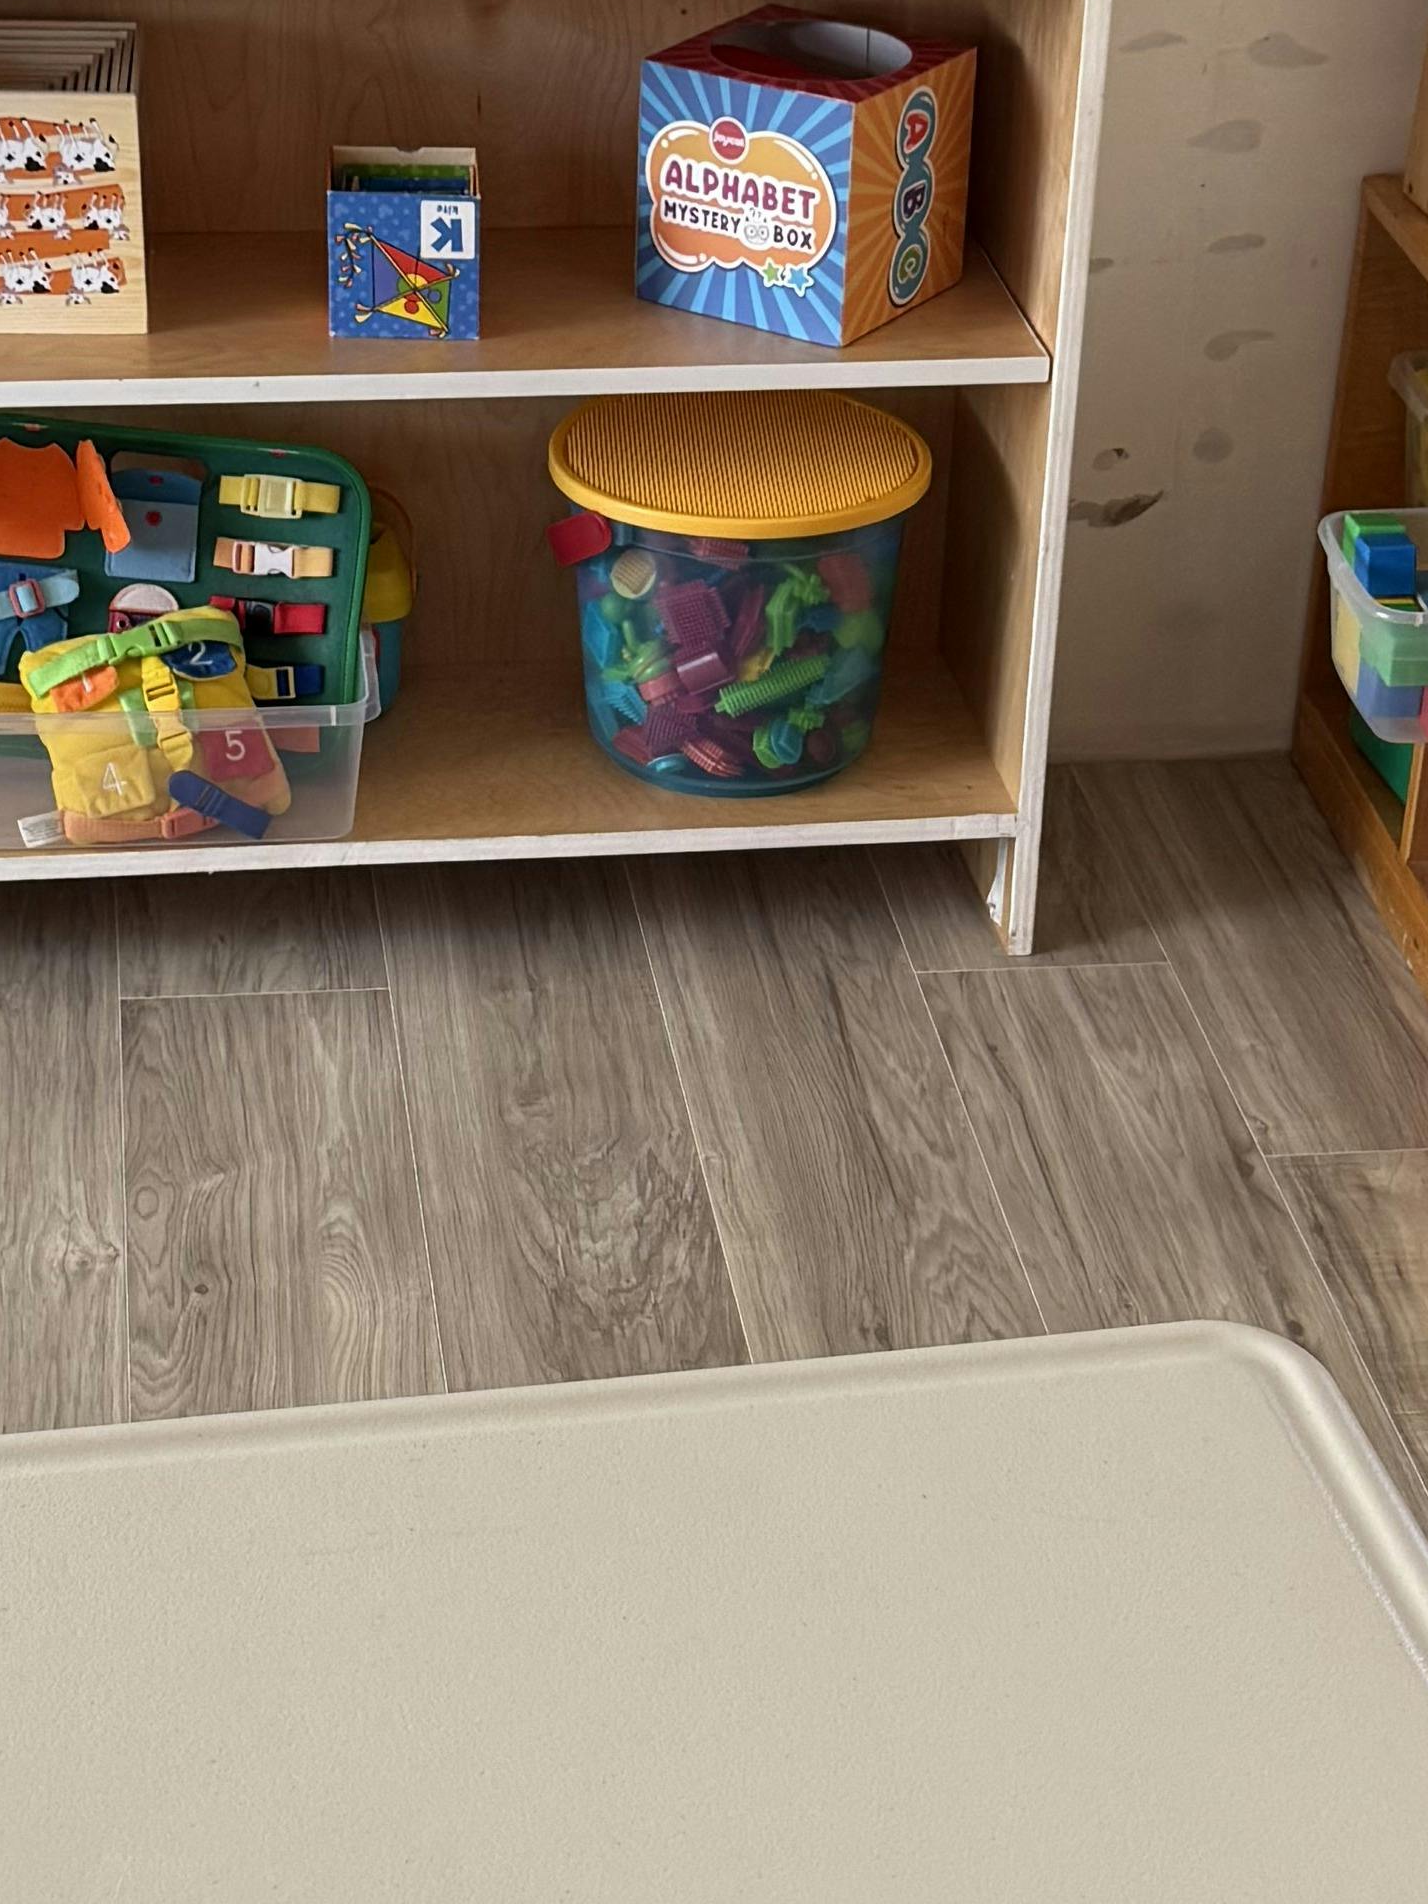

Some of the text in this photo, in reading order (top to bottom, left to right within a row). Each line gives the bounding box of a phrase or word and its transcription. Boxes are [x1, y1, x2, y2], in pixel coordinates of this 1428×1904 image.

[664, 159, 817, 220] ALPHABET
[436, 203, 459, 216] kite
[663, 199, 813, 250] MYSTERY BOX
[429, 217, 464, 253] K
[187, 641, 214, 666] 2
[223, 729, 246, 762] 5
[101, 761, 129, 797] 4
